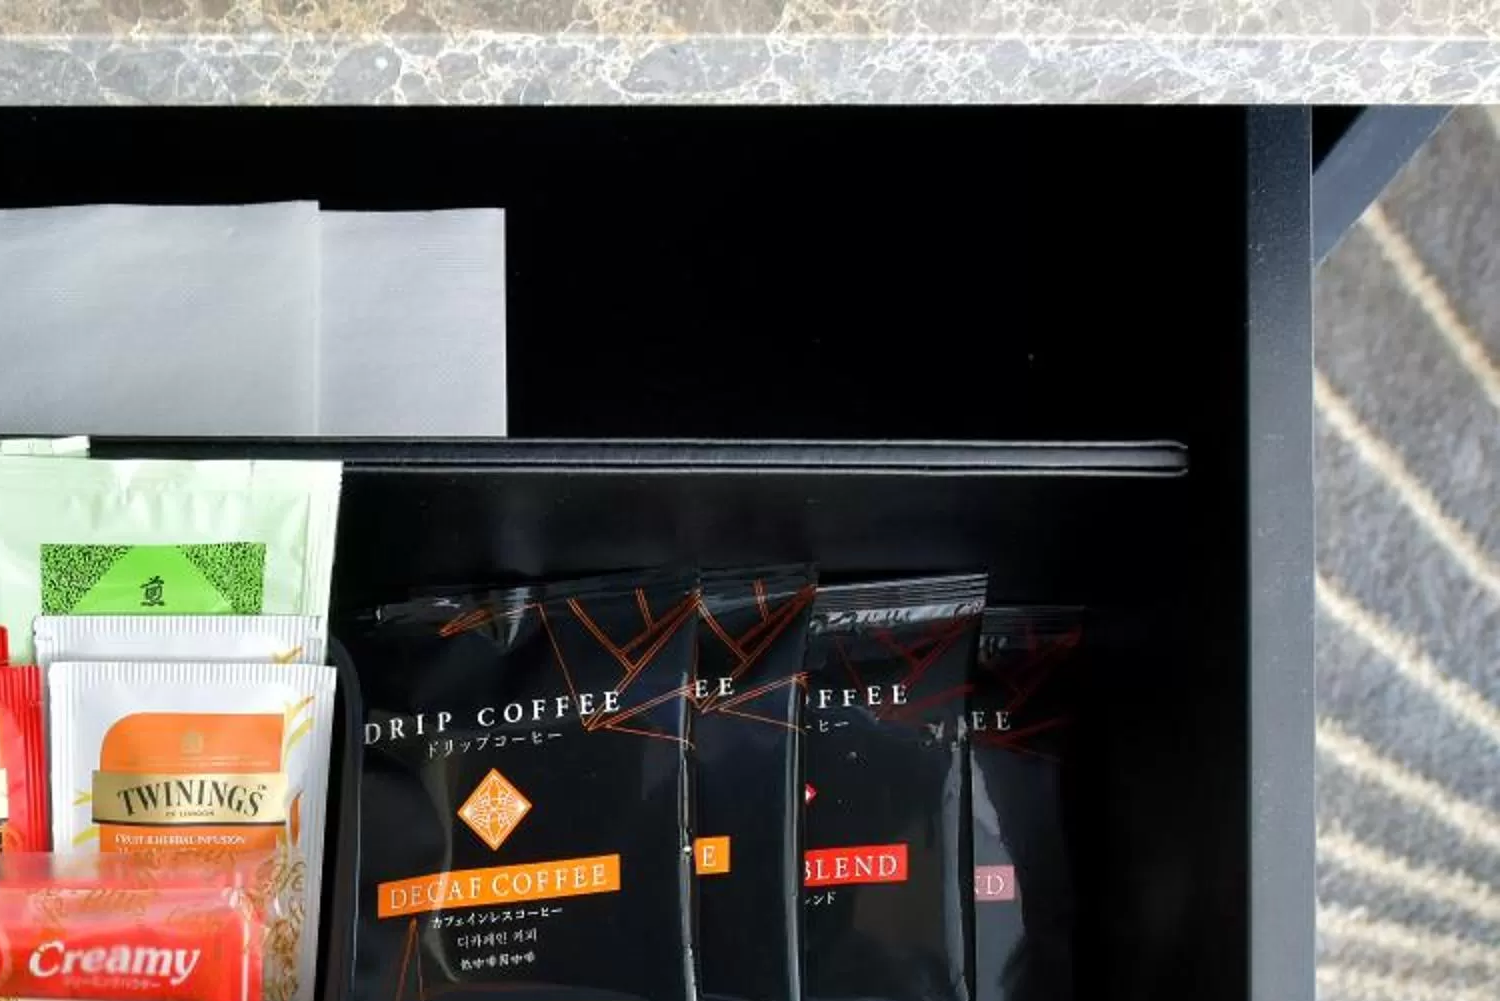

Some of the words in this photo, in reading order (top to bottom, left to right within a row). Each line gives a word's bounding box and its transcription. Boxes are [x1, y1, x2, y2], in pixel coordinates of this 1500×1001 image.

[805, 683, 908, 709] FFEE
[364, 711, 453, 745] DRIP
[476, 691, 621, 727] COFFEE
[427, 731, 564, 761] ドリップコーヒー
[390, 876, 482, 909] DECAF
[491, 863, 608, 897] COFFEE
[432, 906, 564, 929] カフェインレスコーヒー
[29, 941, 201, 986] Creamy
